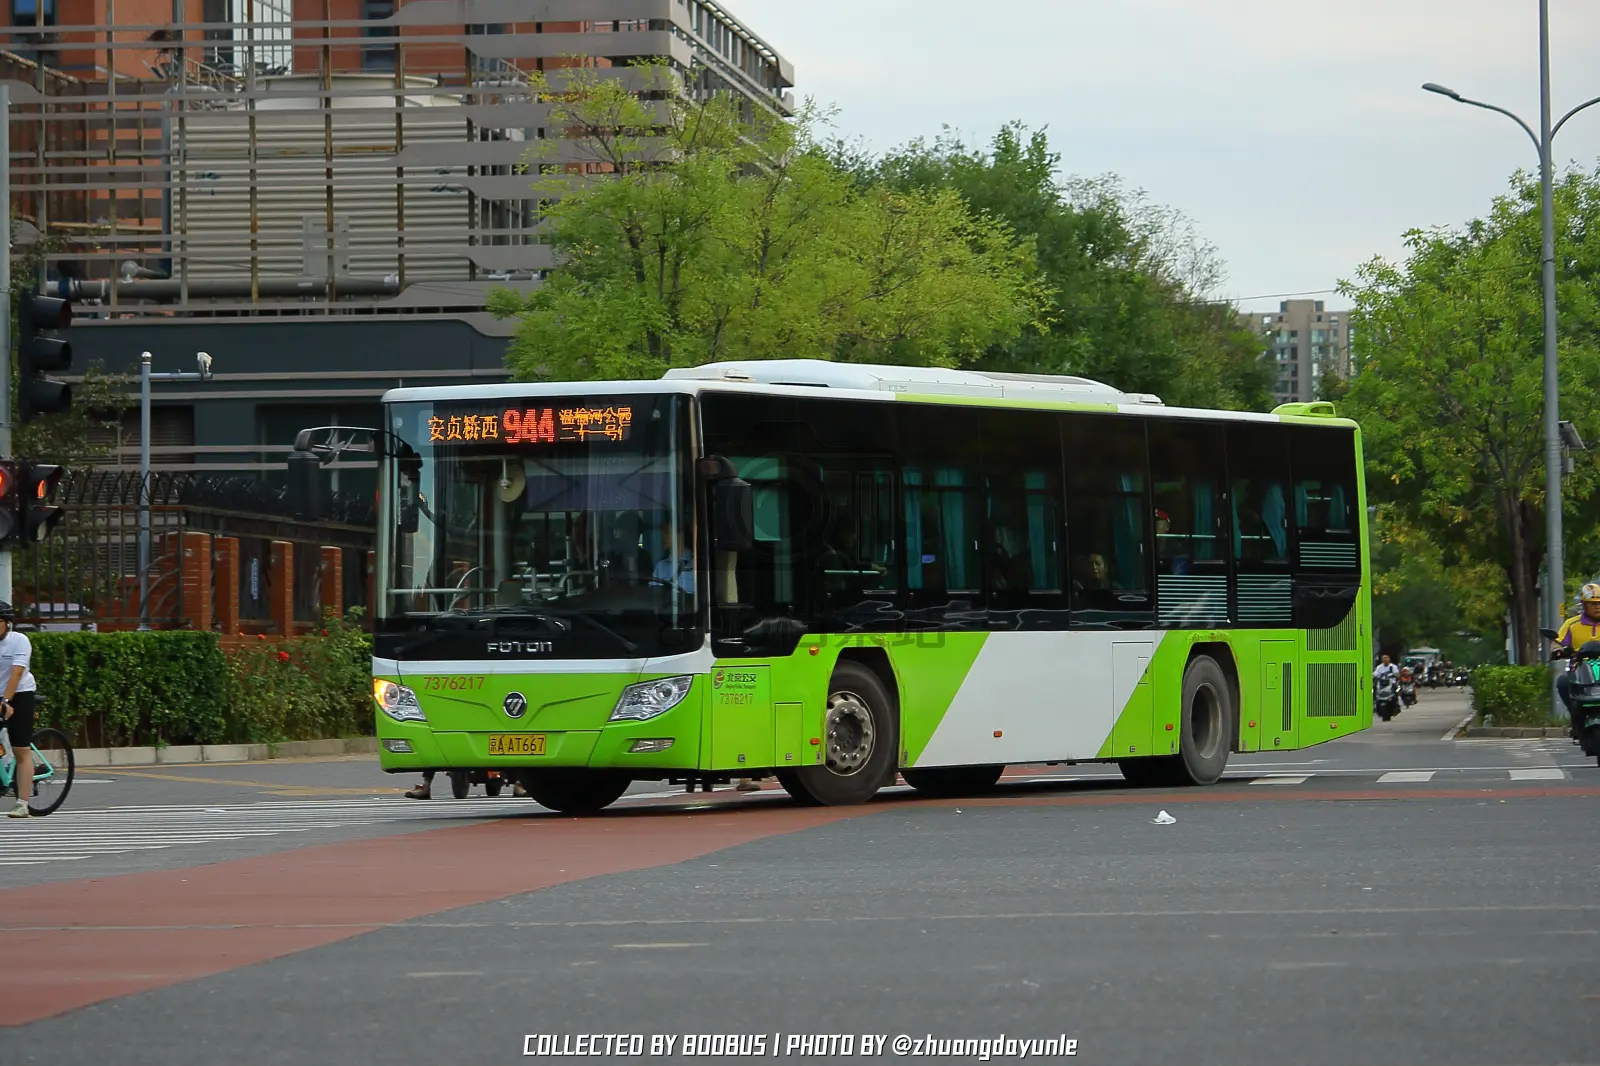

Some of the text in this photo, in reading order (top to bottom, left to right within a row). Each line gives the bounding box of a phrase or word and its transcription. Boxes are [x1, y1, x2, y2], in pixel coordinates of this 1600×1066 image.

[427, 415, 499, 441] 安贞桥西
[503, 408, 555, 443] 944
[487, 641, 552, 653] FOTON
[423, 676, 485, 690] 7376217
[727, 672, 757, 683] 北京公交
[719, 693, 754, 705] 7376217
